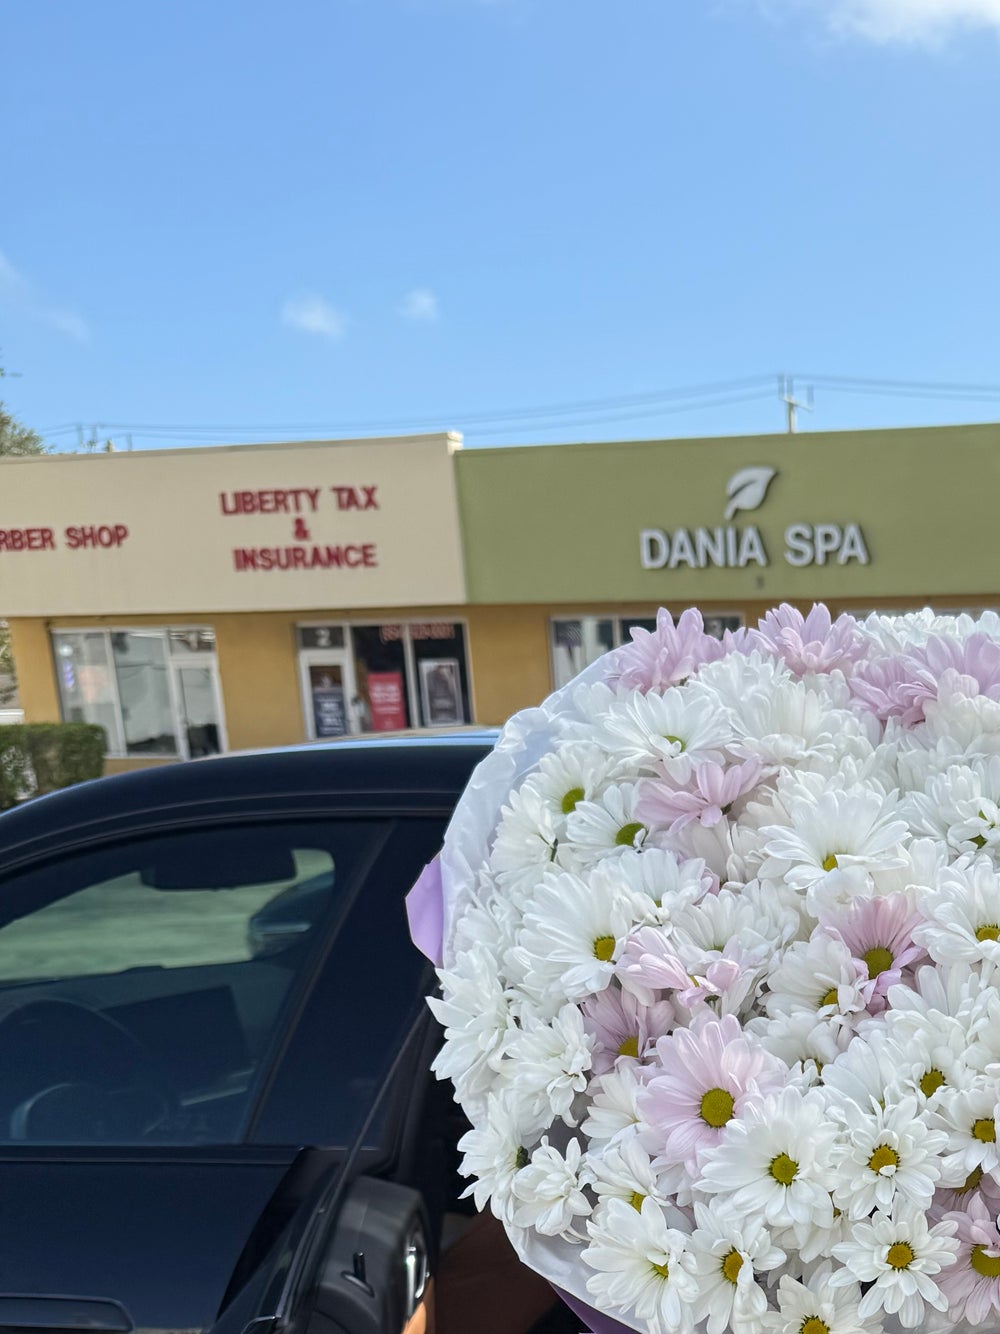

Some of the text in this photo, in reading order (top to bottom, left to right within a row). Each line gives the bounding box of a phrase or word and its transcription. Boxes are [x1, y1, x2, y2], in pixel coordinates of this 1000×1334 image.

[220, 486, 379, 515] LIBERTY TAX
[65, 524, 128, 549] SHOP
[293, 517, 310, 541] &
[233, 544, 378, 572] INSURANCE
[639, 522, 870, 569] DANIA SPA
